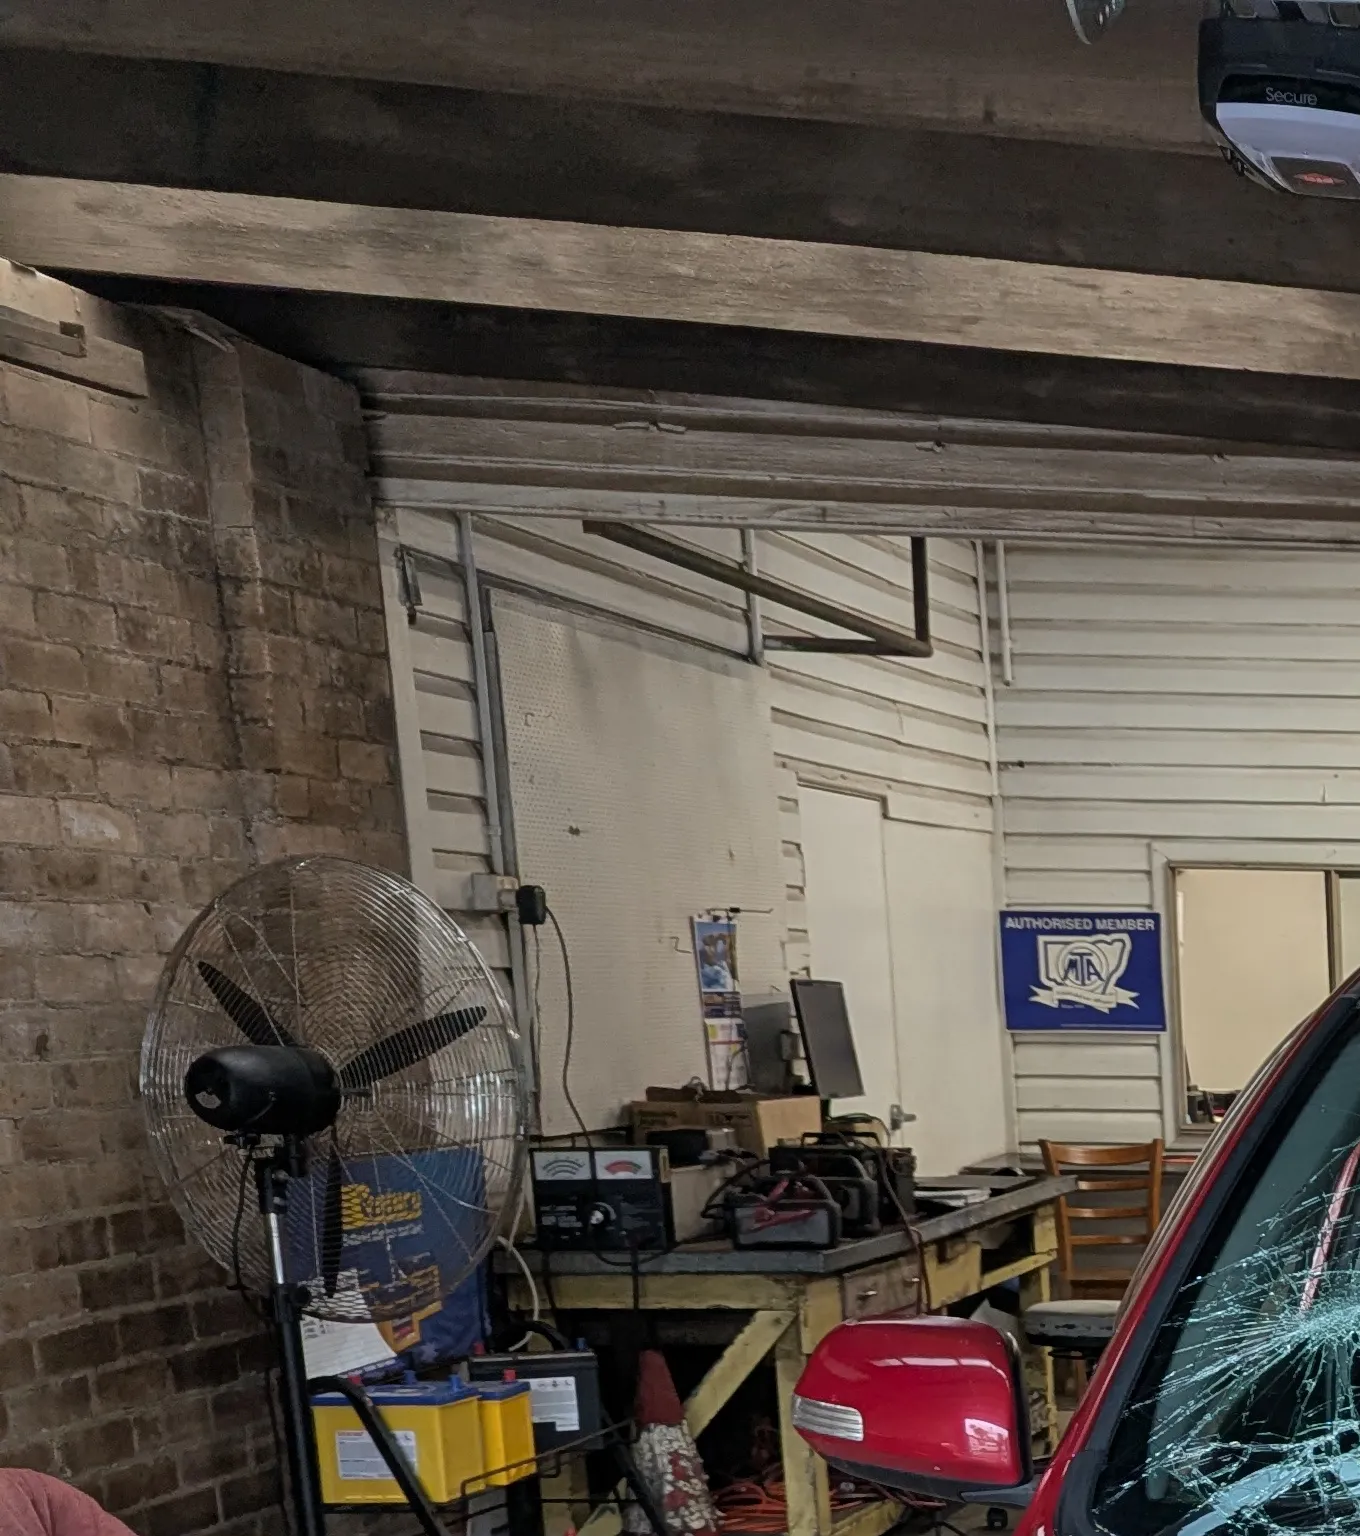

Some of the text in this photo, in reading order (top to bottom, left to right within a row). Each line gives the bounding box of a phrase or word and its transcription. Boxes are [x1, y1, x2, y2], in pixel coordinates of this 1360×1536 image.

[1266, 87, 1317, 105] Secure
[1005, 917, 1155, 931] AUTHORISED MEMBER
[1063, 951, 1105, 986] MTA
